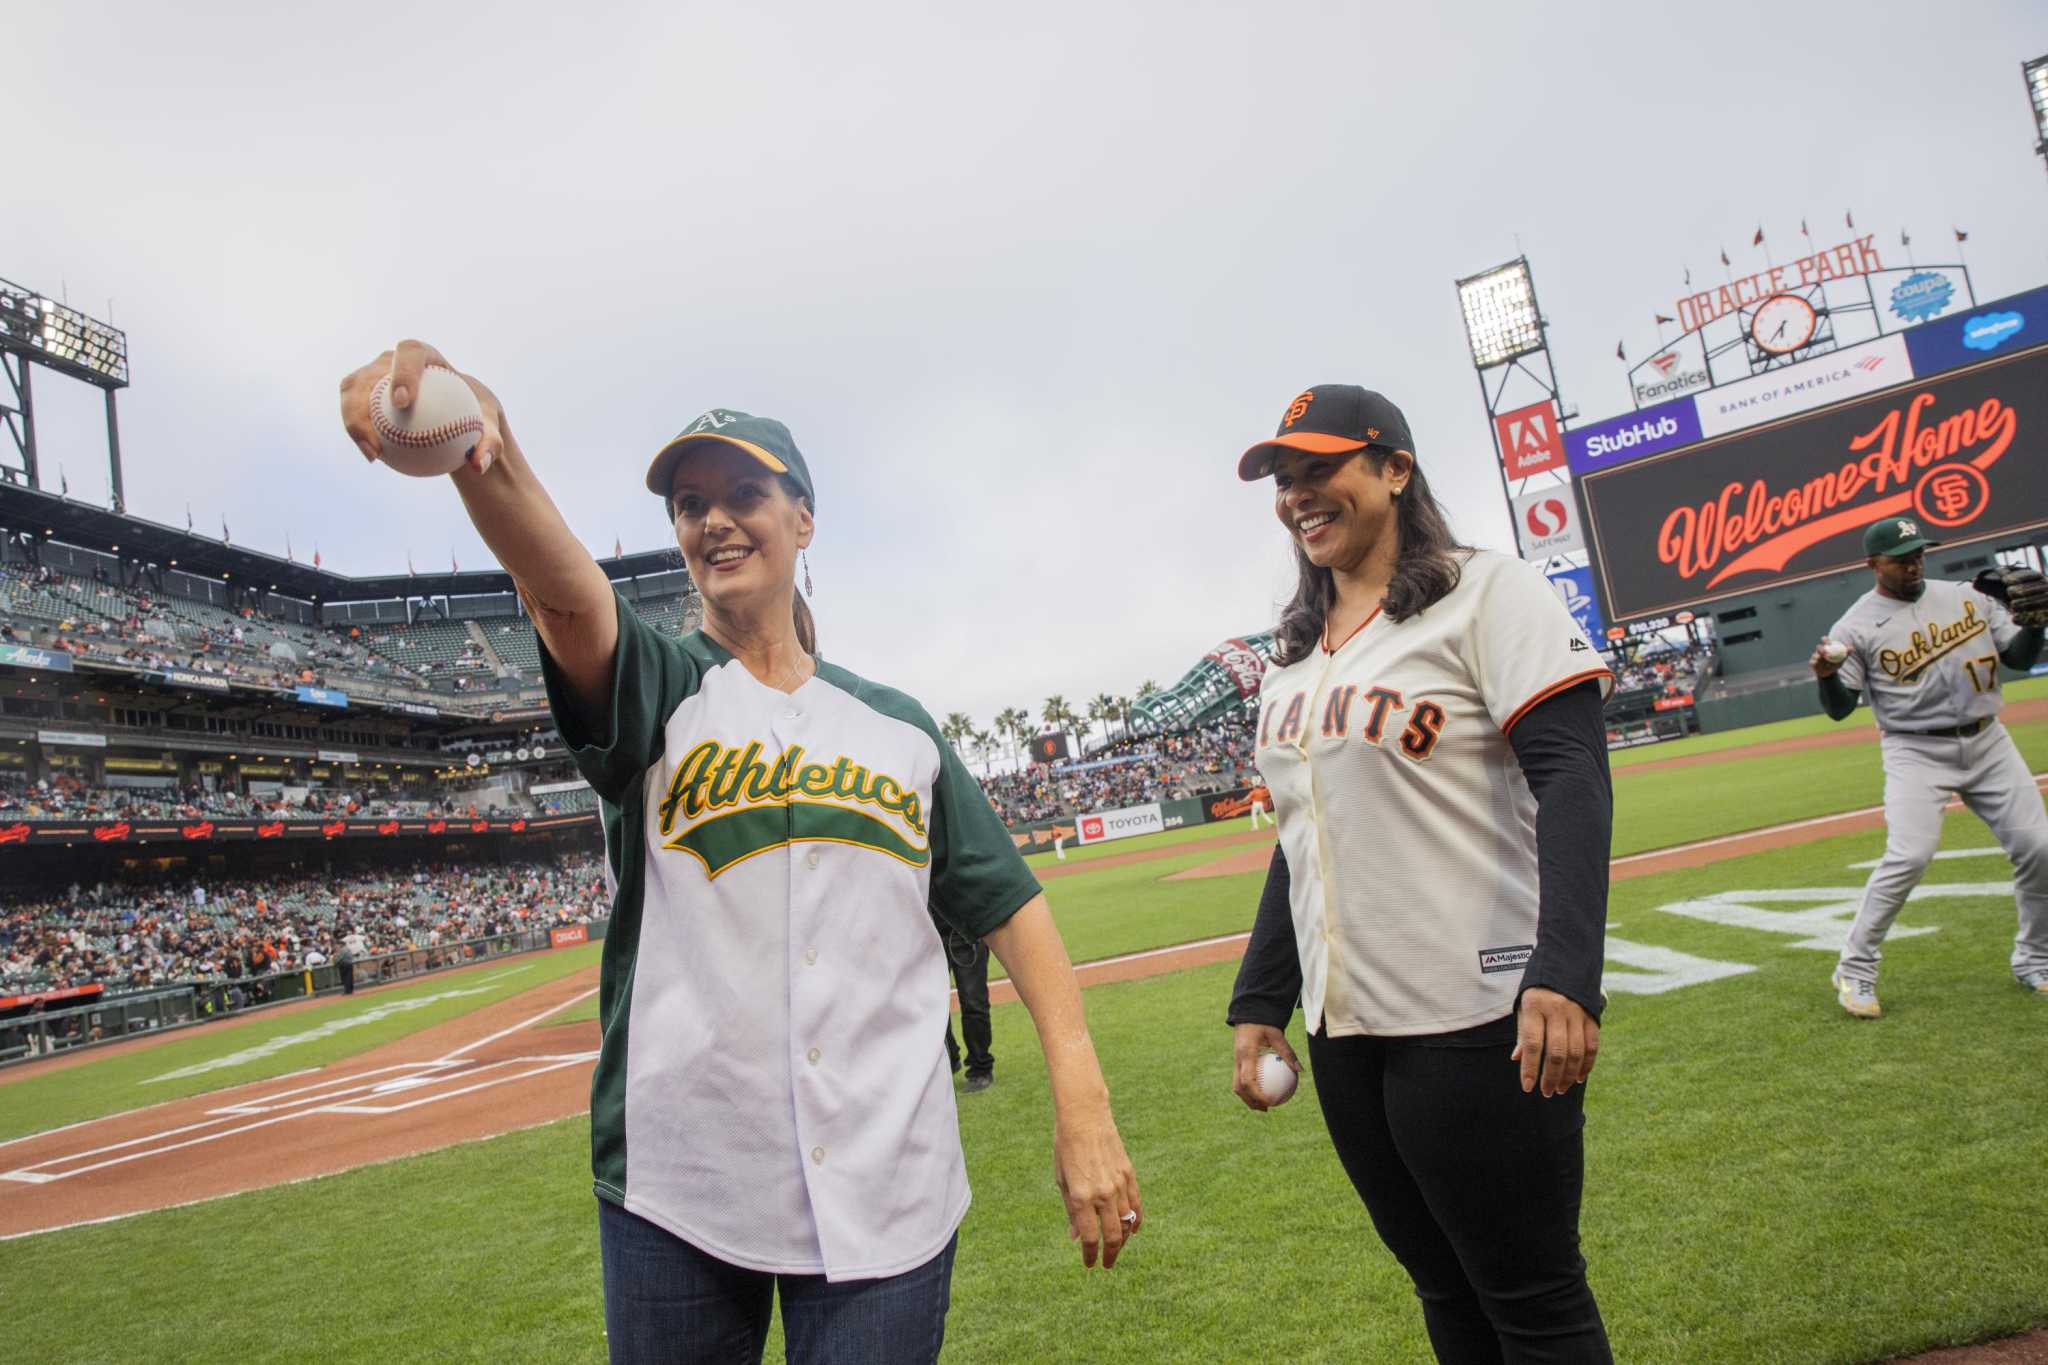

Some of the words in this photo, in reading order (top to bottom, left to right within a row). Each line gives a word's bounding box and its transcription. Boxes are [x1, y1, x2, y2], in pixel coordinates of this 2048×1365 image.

[1677, 266, 1788, 334] ORACLE
[1795, 234, 1885, 286] PARK
[1635, 369, 1707, 402] Fanatics
[1719, 397, 1759, 415] BANK
[1761, 388, 1780, 402] OF
[1784, 369, 1852, 396] AMERICA
[1585, 416, 1678, 458] StubHub
[1517, 449, 1552, 469] Adobe
[1657, 460, 1872, 580] Welcome
[1848, 392, 2016, 494] Home
[1531, 533, 1572, 551] SAFEWAY
[1879, 600, 1986, 678] Oakland
[1964, 655, 1998, 693] 17
[1258, 684, 1447, 764] IANTS
[659, 739, 927, 837] Athletics
[1108, 814, 1158, 831] TOYOTA
[1497, 952, 1530, 963] Majestic
